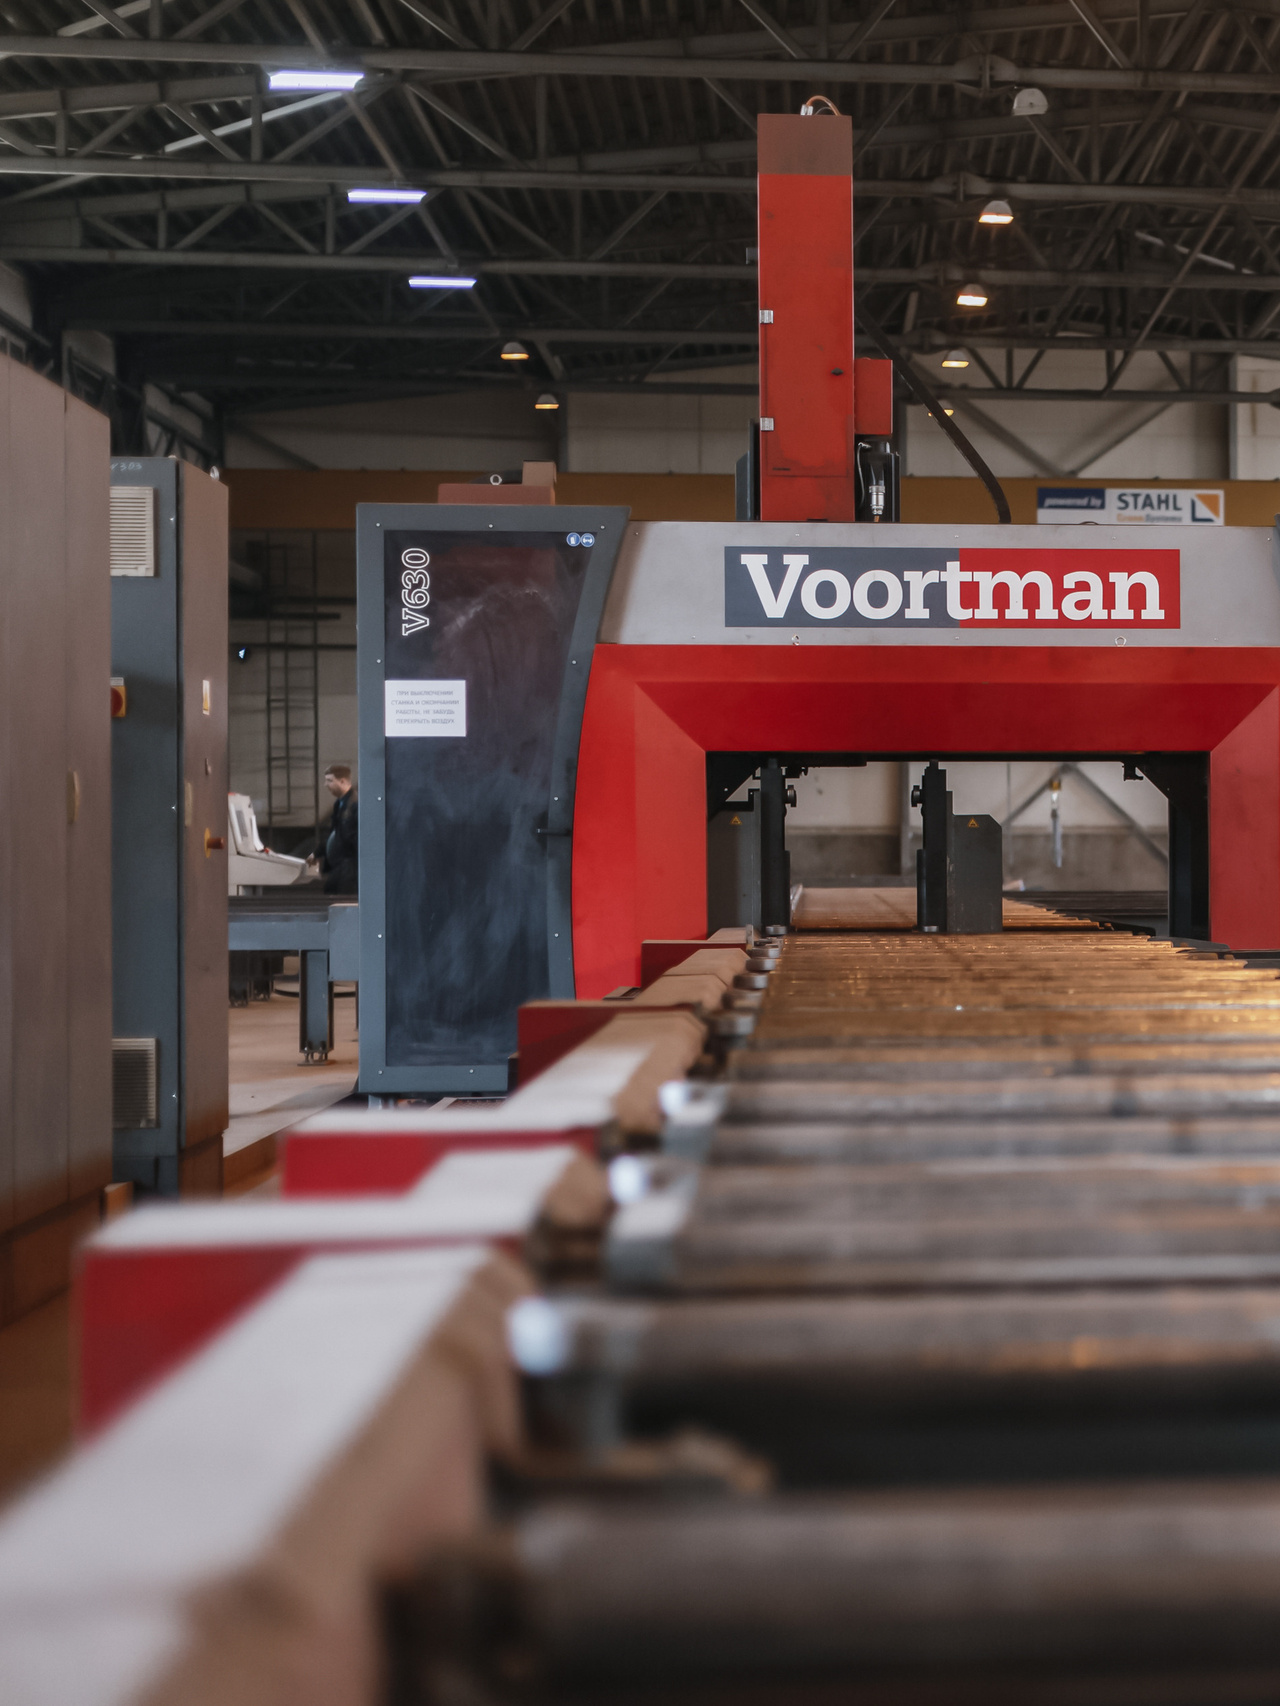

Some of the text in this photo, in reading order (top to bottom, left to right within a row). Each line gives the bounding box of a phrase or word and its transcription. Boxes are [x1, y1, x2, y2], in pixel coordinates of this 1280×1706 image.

[1117, 493, 1182, 511] STAHL
[401, 547, 430, 636] V630
[740, 553, 1166, 621] Voortman
